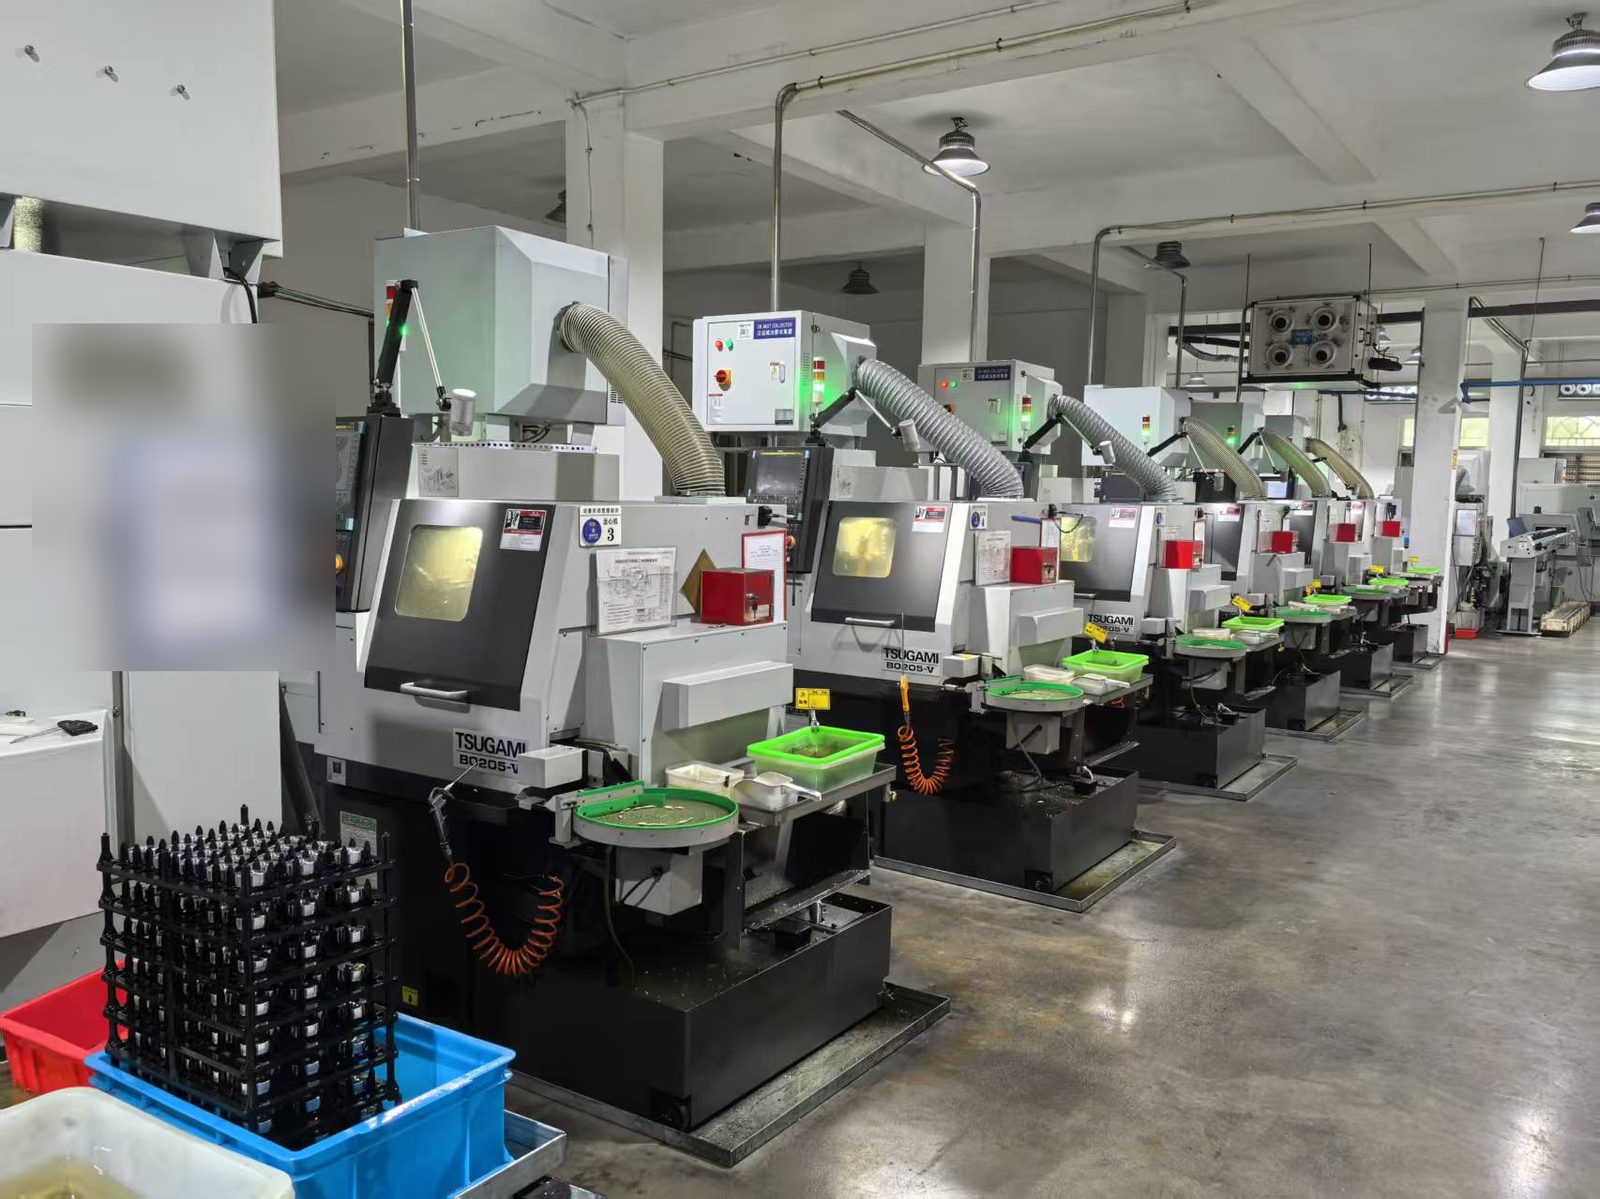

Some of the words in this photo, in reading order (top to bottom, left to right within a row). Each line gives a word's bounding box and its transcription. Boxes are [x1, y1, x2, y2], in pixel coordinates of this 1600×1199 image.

[607, 527, 614, 541] 3
[1088, 614, 1134, 626] TSUGAMI
[883, 647, 939, 664] TSUGAMI
[455, 731, 526, 758] TSUGAMI
